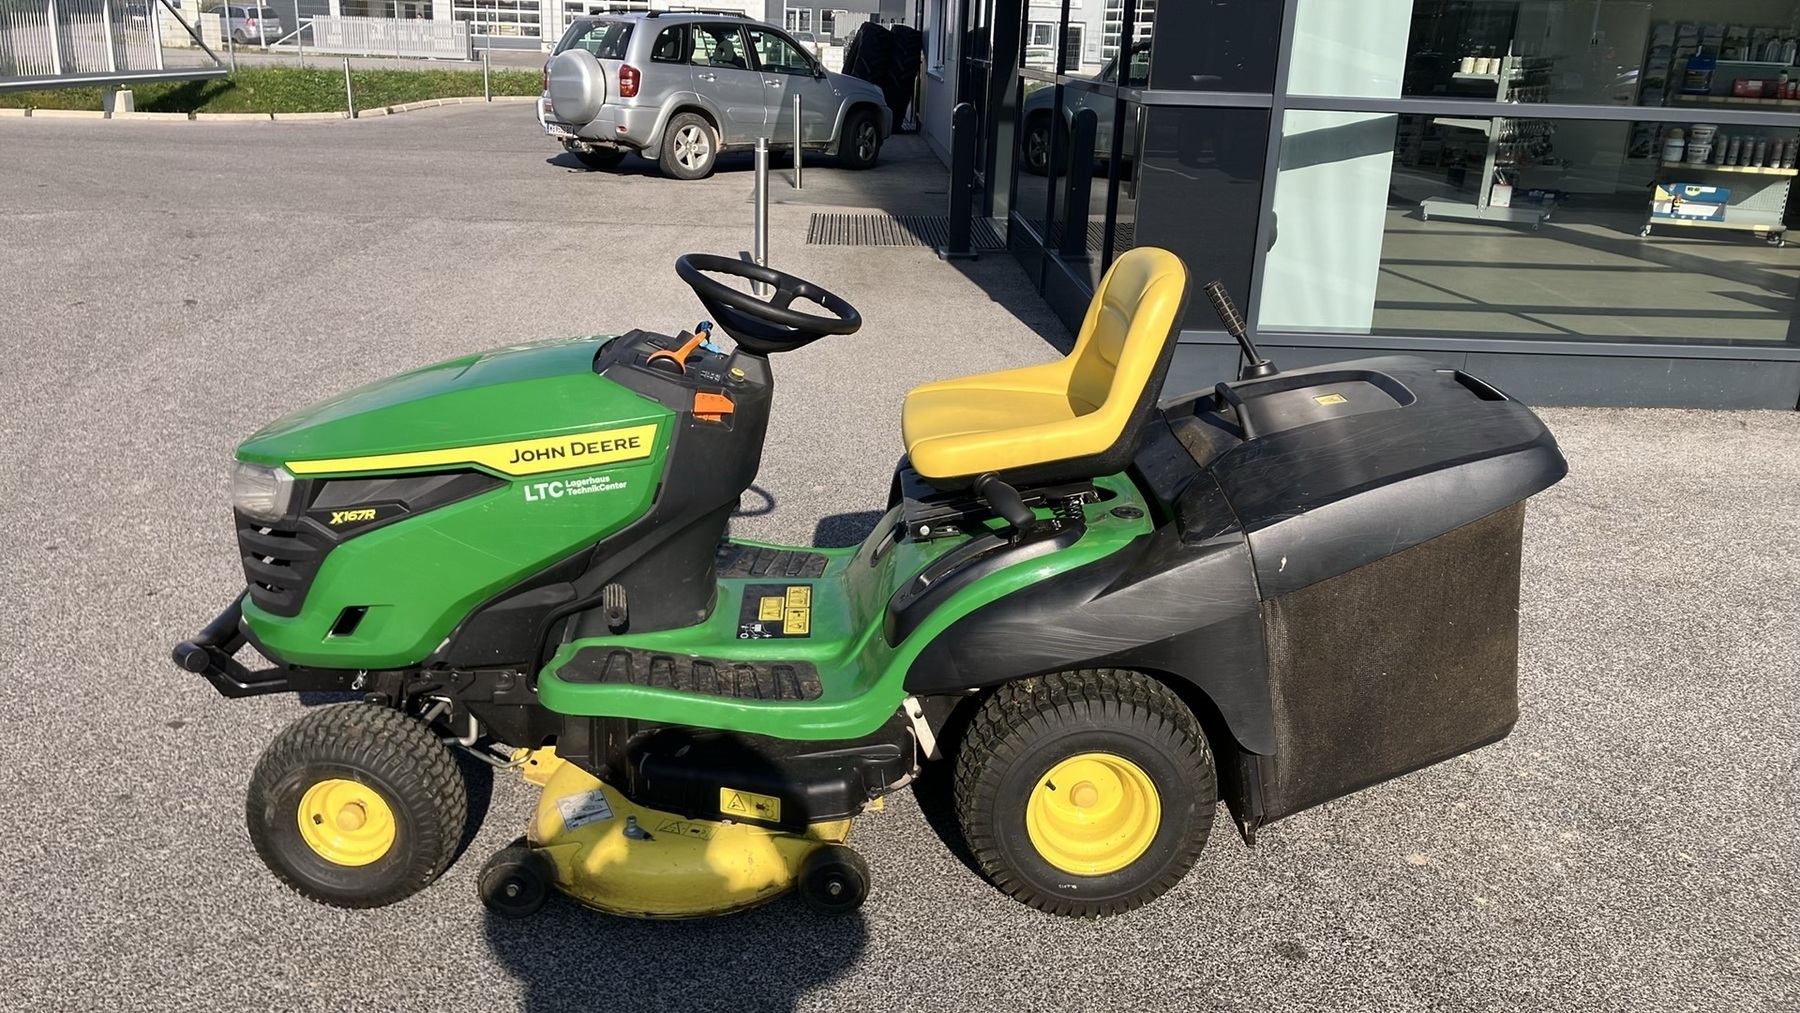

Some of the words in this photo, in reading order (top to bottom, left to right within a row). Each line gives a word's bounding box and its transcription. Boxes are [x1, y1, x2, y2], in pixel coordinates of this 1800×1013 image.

[510, 446, 566, 464] JOHN
[570, 436, 641, 457] DEERE
[565, 476, 611, 488] Lagerhaus
[566, 481, 628, 496] TechnikCenter
[524, 481, 564, 502] LTC
[329, 508, 377, 525] X167R
